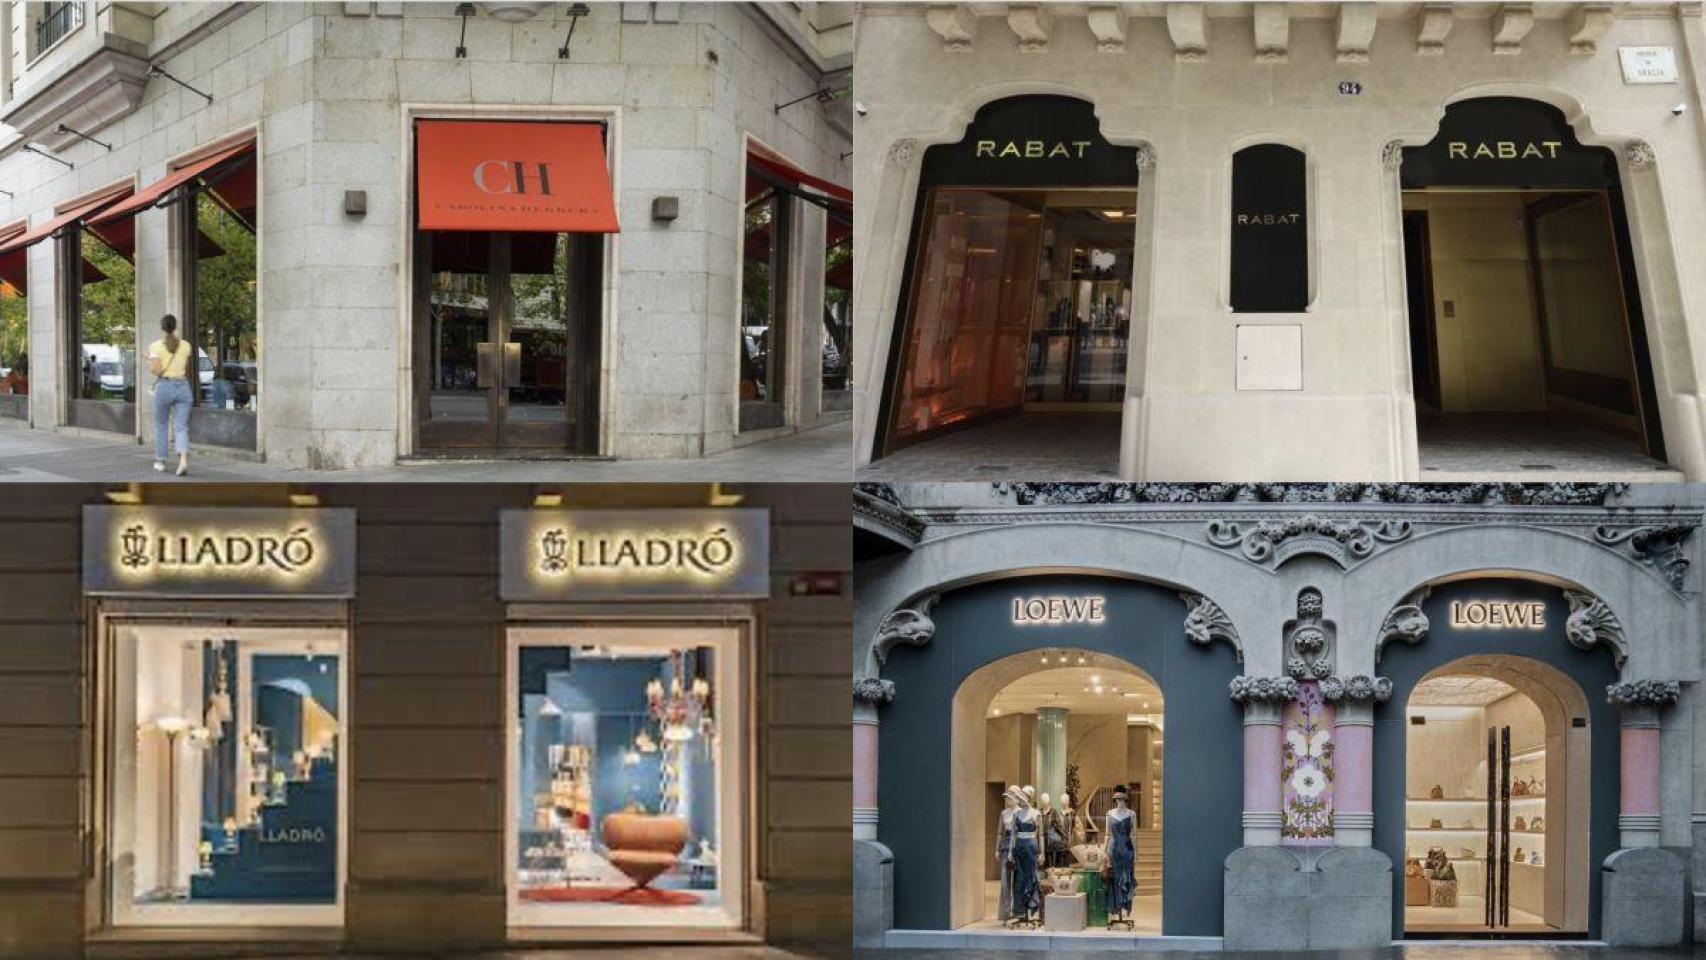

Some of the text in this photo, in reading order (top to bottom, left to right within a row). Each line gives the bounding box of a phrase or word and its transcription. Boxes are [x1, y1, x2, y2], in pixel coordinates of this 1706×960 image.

[976, 140, 1092, 158] RABAT
[1448, 141, 1562, 159] RABAT
[472, 160, 553, 196] CH
[1237, 213, 1300, 225] RABAT
[157, 528, 314, 572] LLADRÓ
[576, 528, 733, 574] LLADRÓ
[1014, 598, 1104, 621] LOEWE
[1455, 603, 1545, 625] LOEWE
